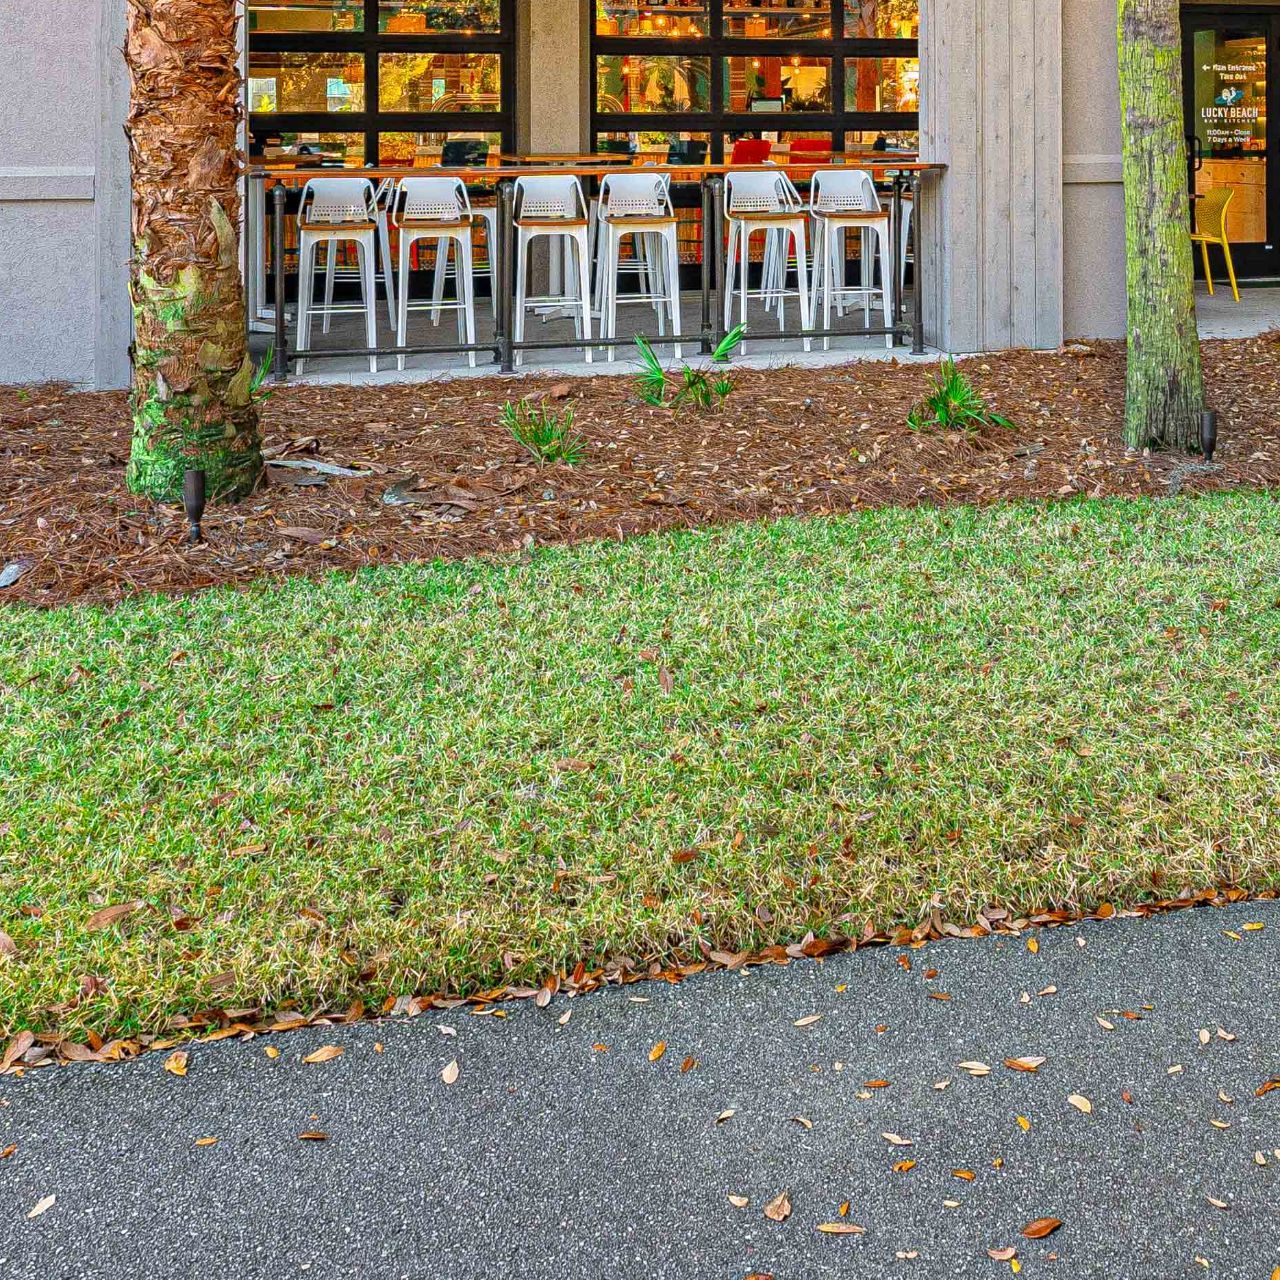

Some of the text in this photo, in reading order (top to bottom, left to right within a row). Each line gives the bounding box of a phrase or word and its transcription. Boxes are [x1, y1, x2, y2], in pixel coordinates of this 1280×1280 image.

[1201, 107, 1258, 118] LUCKY BEACH
[1212, 136, 1227, 144] Days
